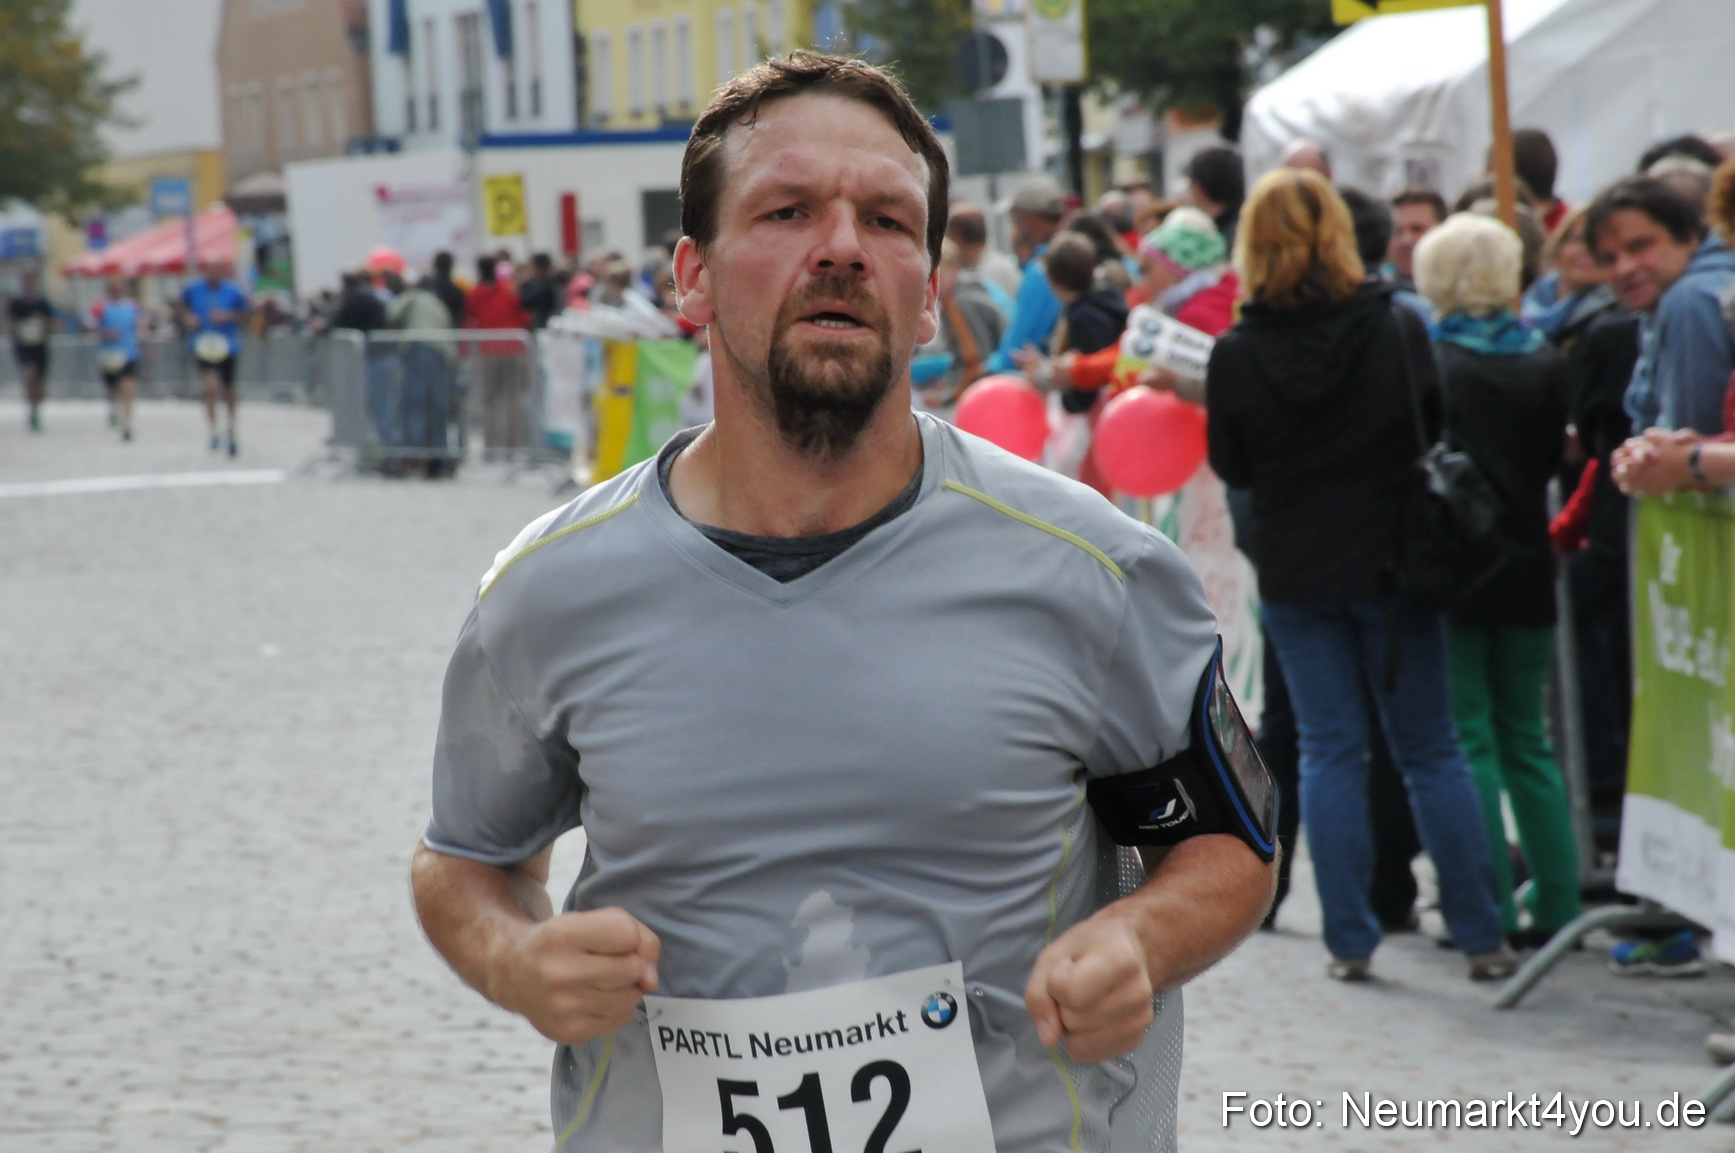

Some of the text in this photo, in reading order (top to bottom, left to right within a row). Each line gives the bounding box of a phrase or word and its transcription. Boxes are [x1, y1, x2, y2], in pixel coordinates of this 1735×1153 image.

[1160, 810, 1190, 829] TOUC
[658, 1009, 909, 1059] PARTL Neumarkt
[716, 1059, 923, 1153] 512
